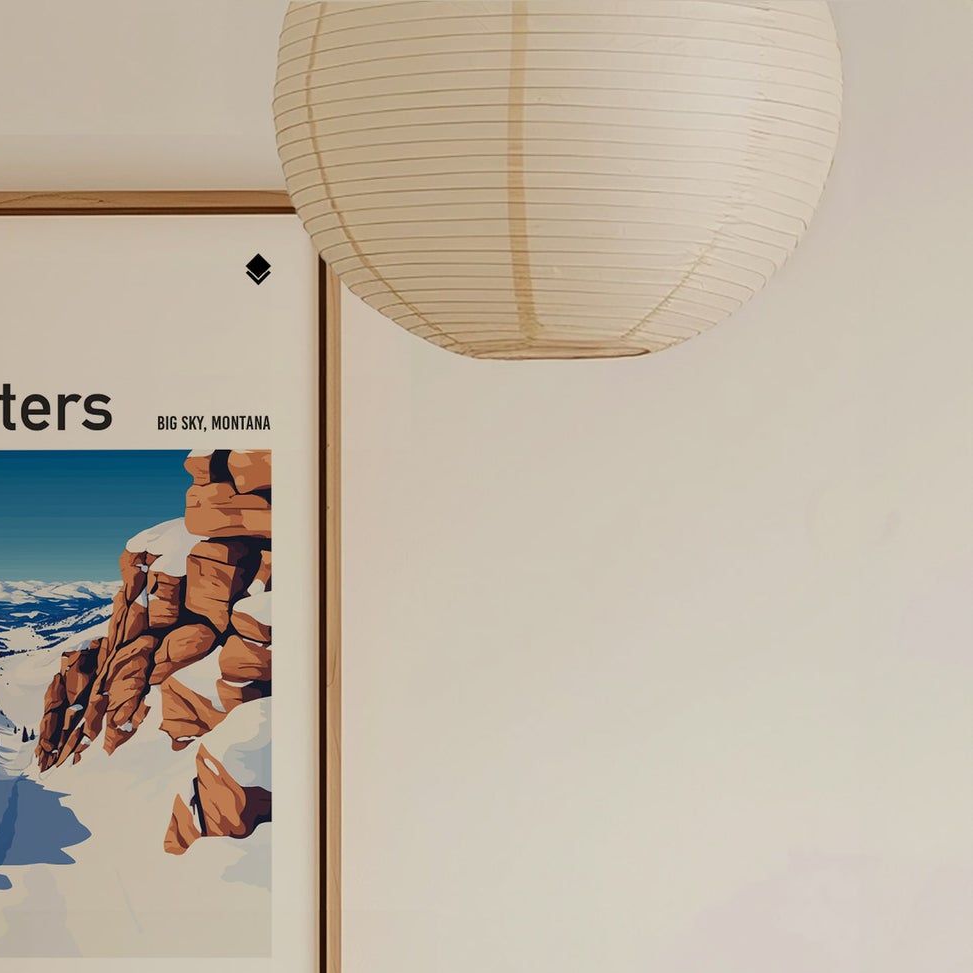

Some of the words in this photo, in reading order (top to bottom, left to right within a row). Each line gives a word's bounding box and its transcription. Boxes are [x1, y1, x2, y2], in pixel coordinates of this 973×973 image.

[158, 416, 177, 430] BIG
[182, 416, 207, 432] SKY,
[212, 416, 271, 430] MONTANA
